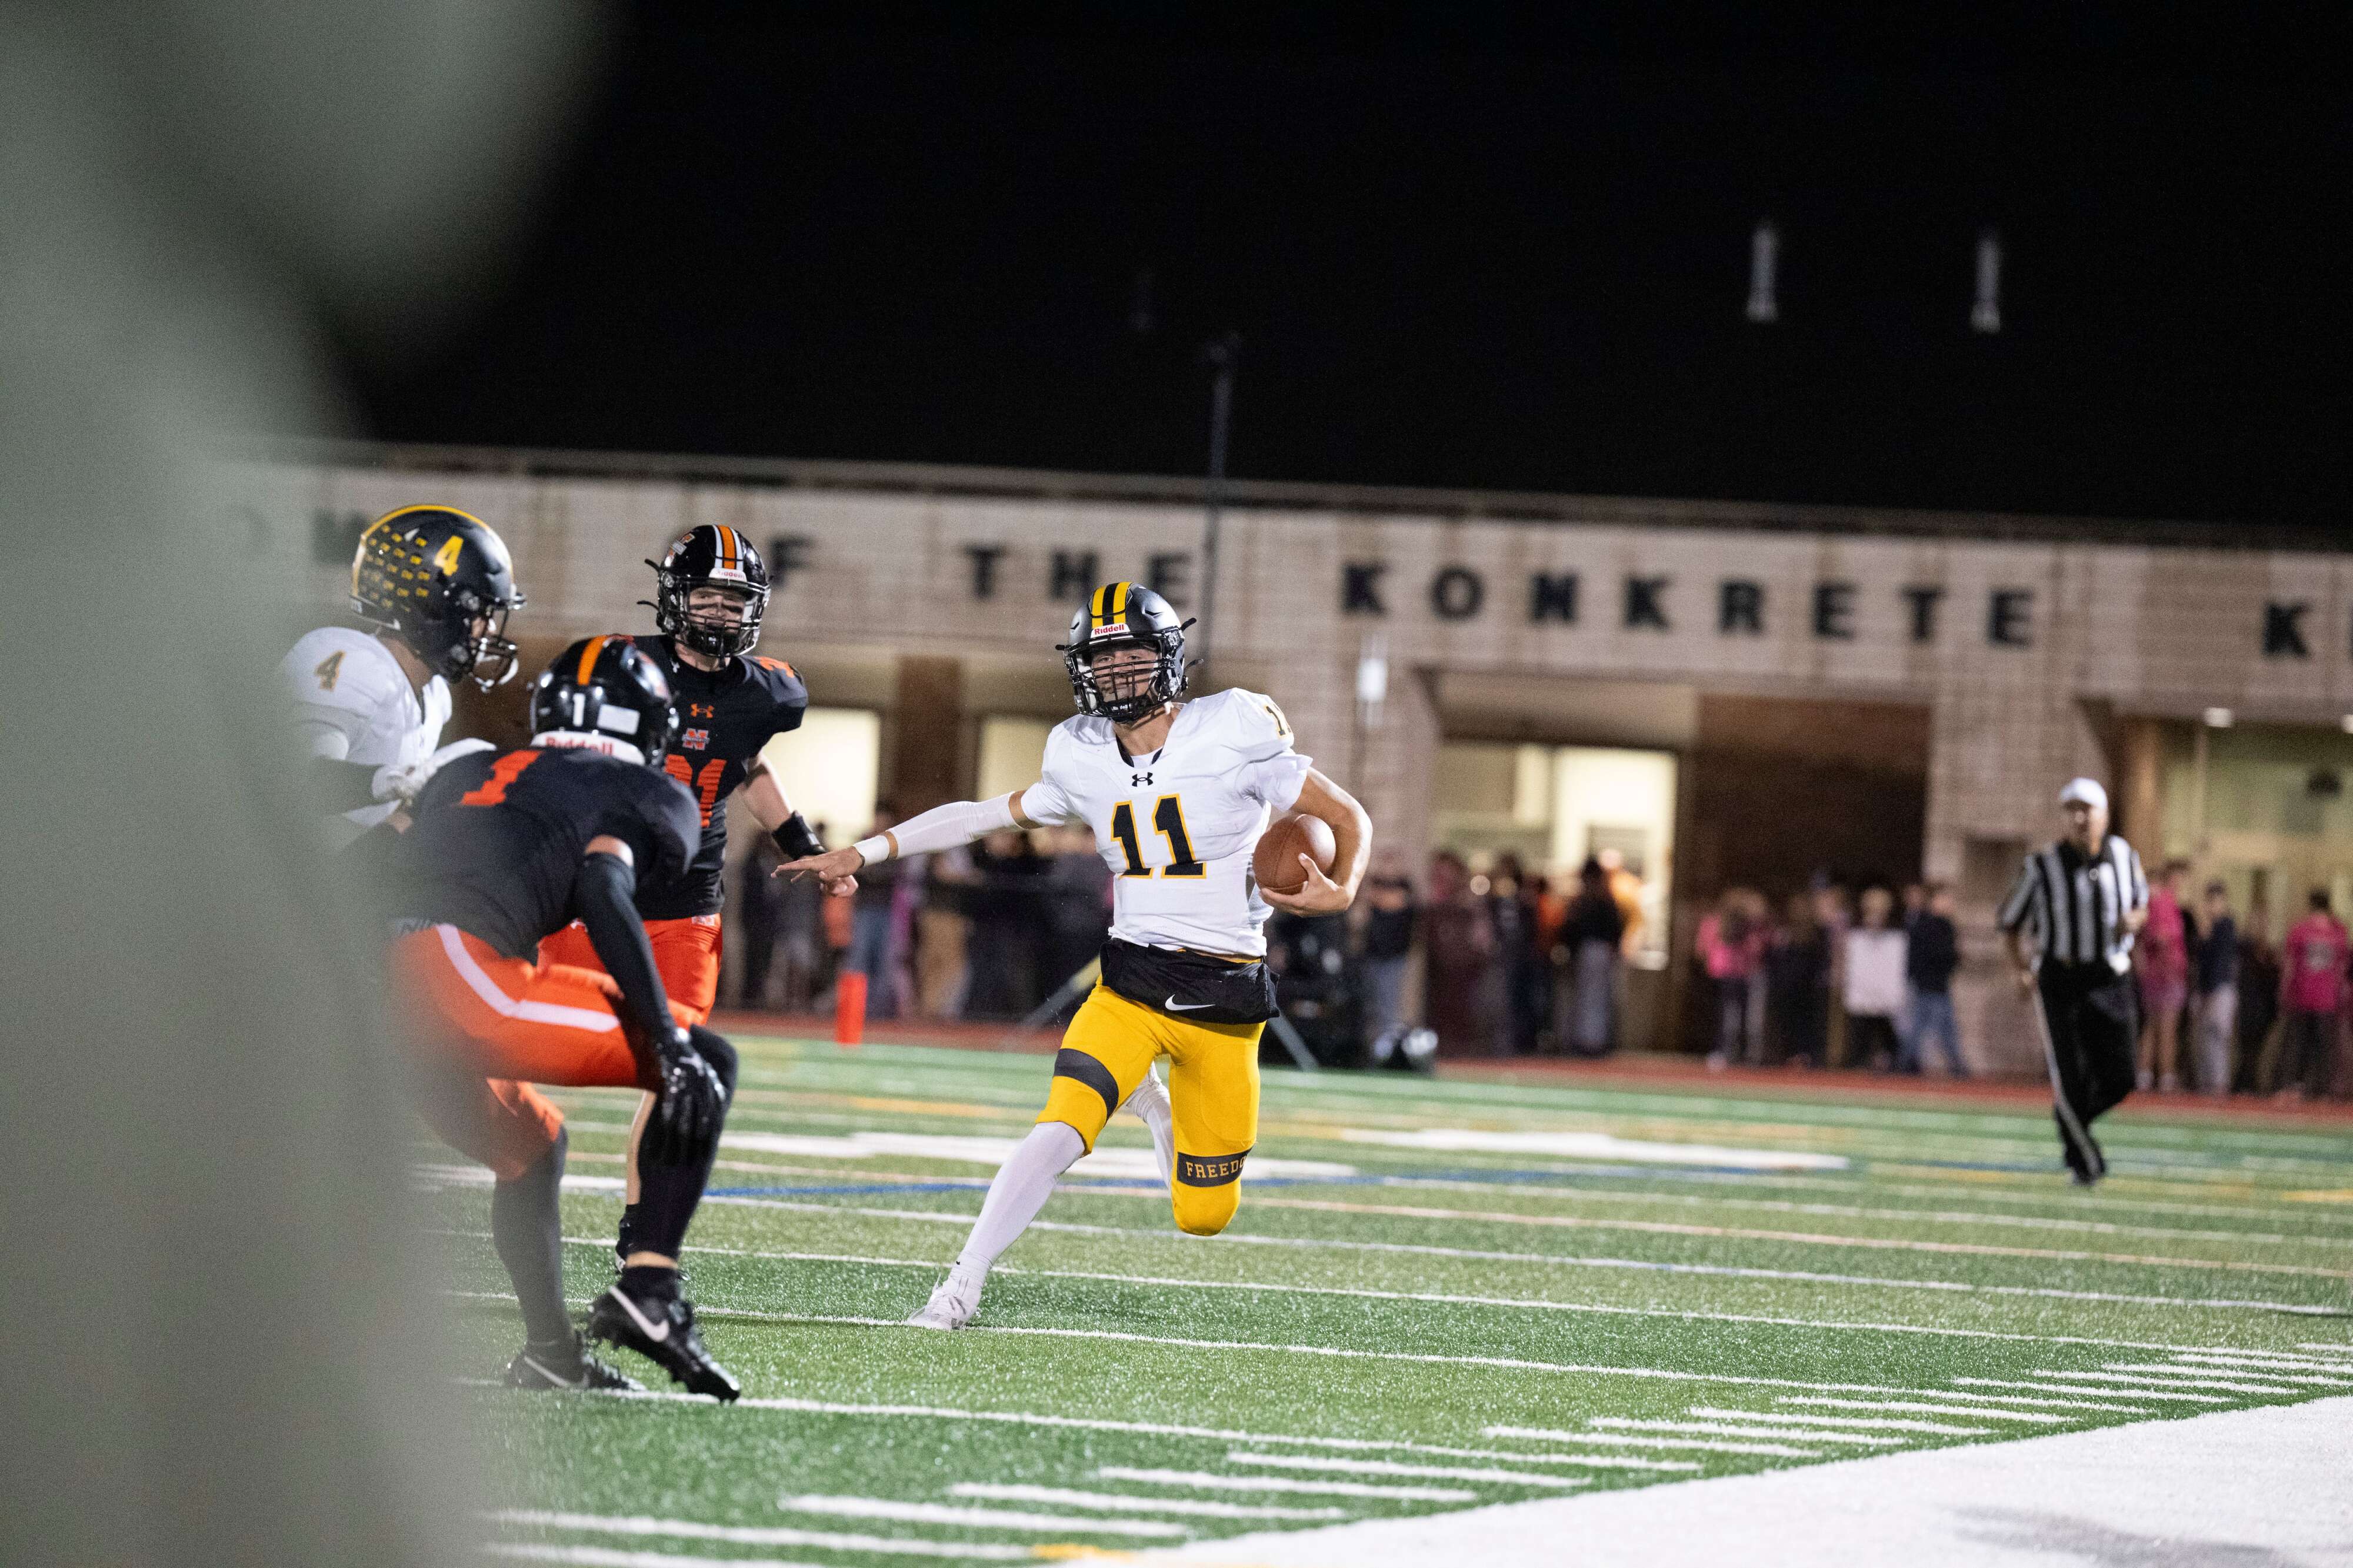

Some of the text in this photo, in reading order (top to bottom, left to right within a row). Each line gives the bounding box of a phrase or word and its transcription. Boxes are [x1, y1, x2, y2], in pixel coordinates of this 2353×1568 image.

[434, 536, 464, 576] 4
[965, 543, 1192, 608] THE
[1340, 561, 2035, 648] KONKRETE
[1094, 624, 1125, 635] Riddell
[314, 650, 346, 692] 4
[572, 693, 586, 727] 1
[1110, 793, 1207, 879] 11
